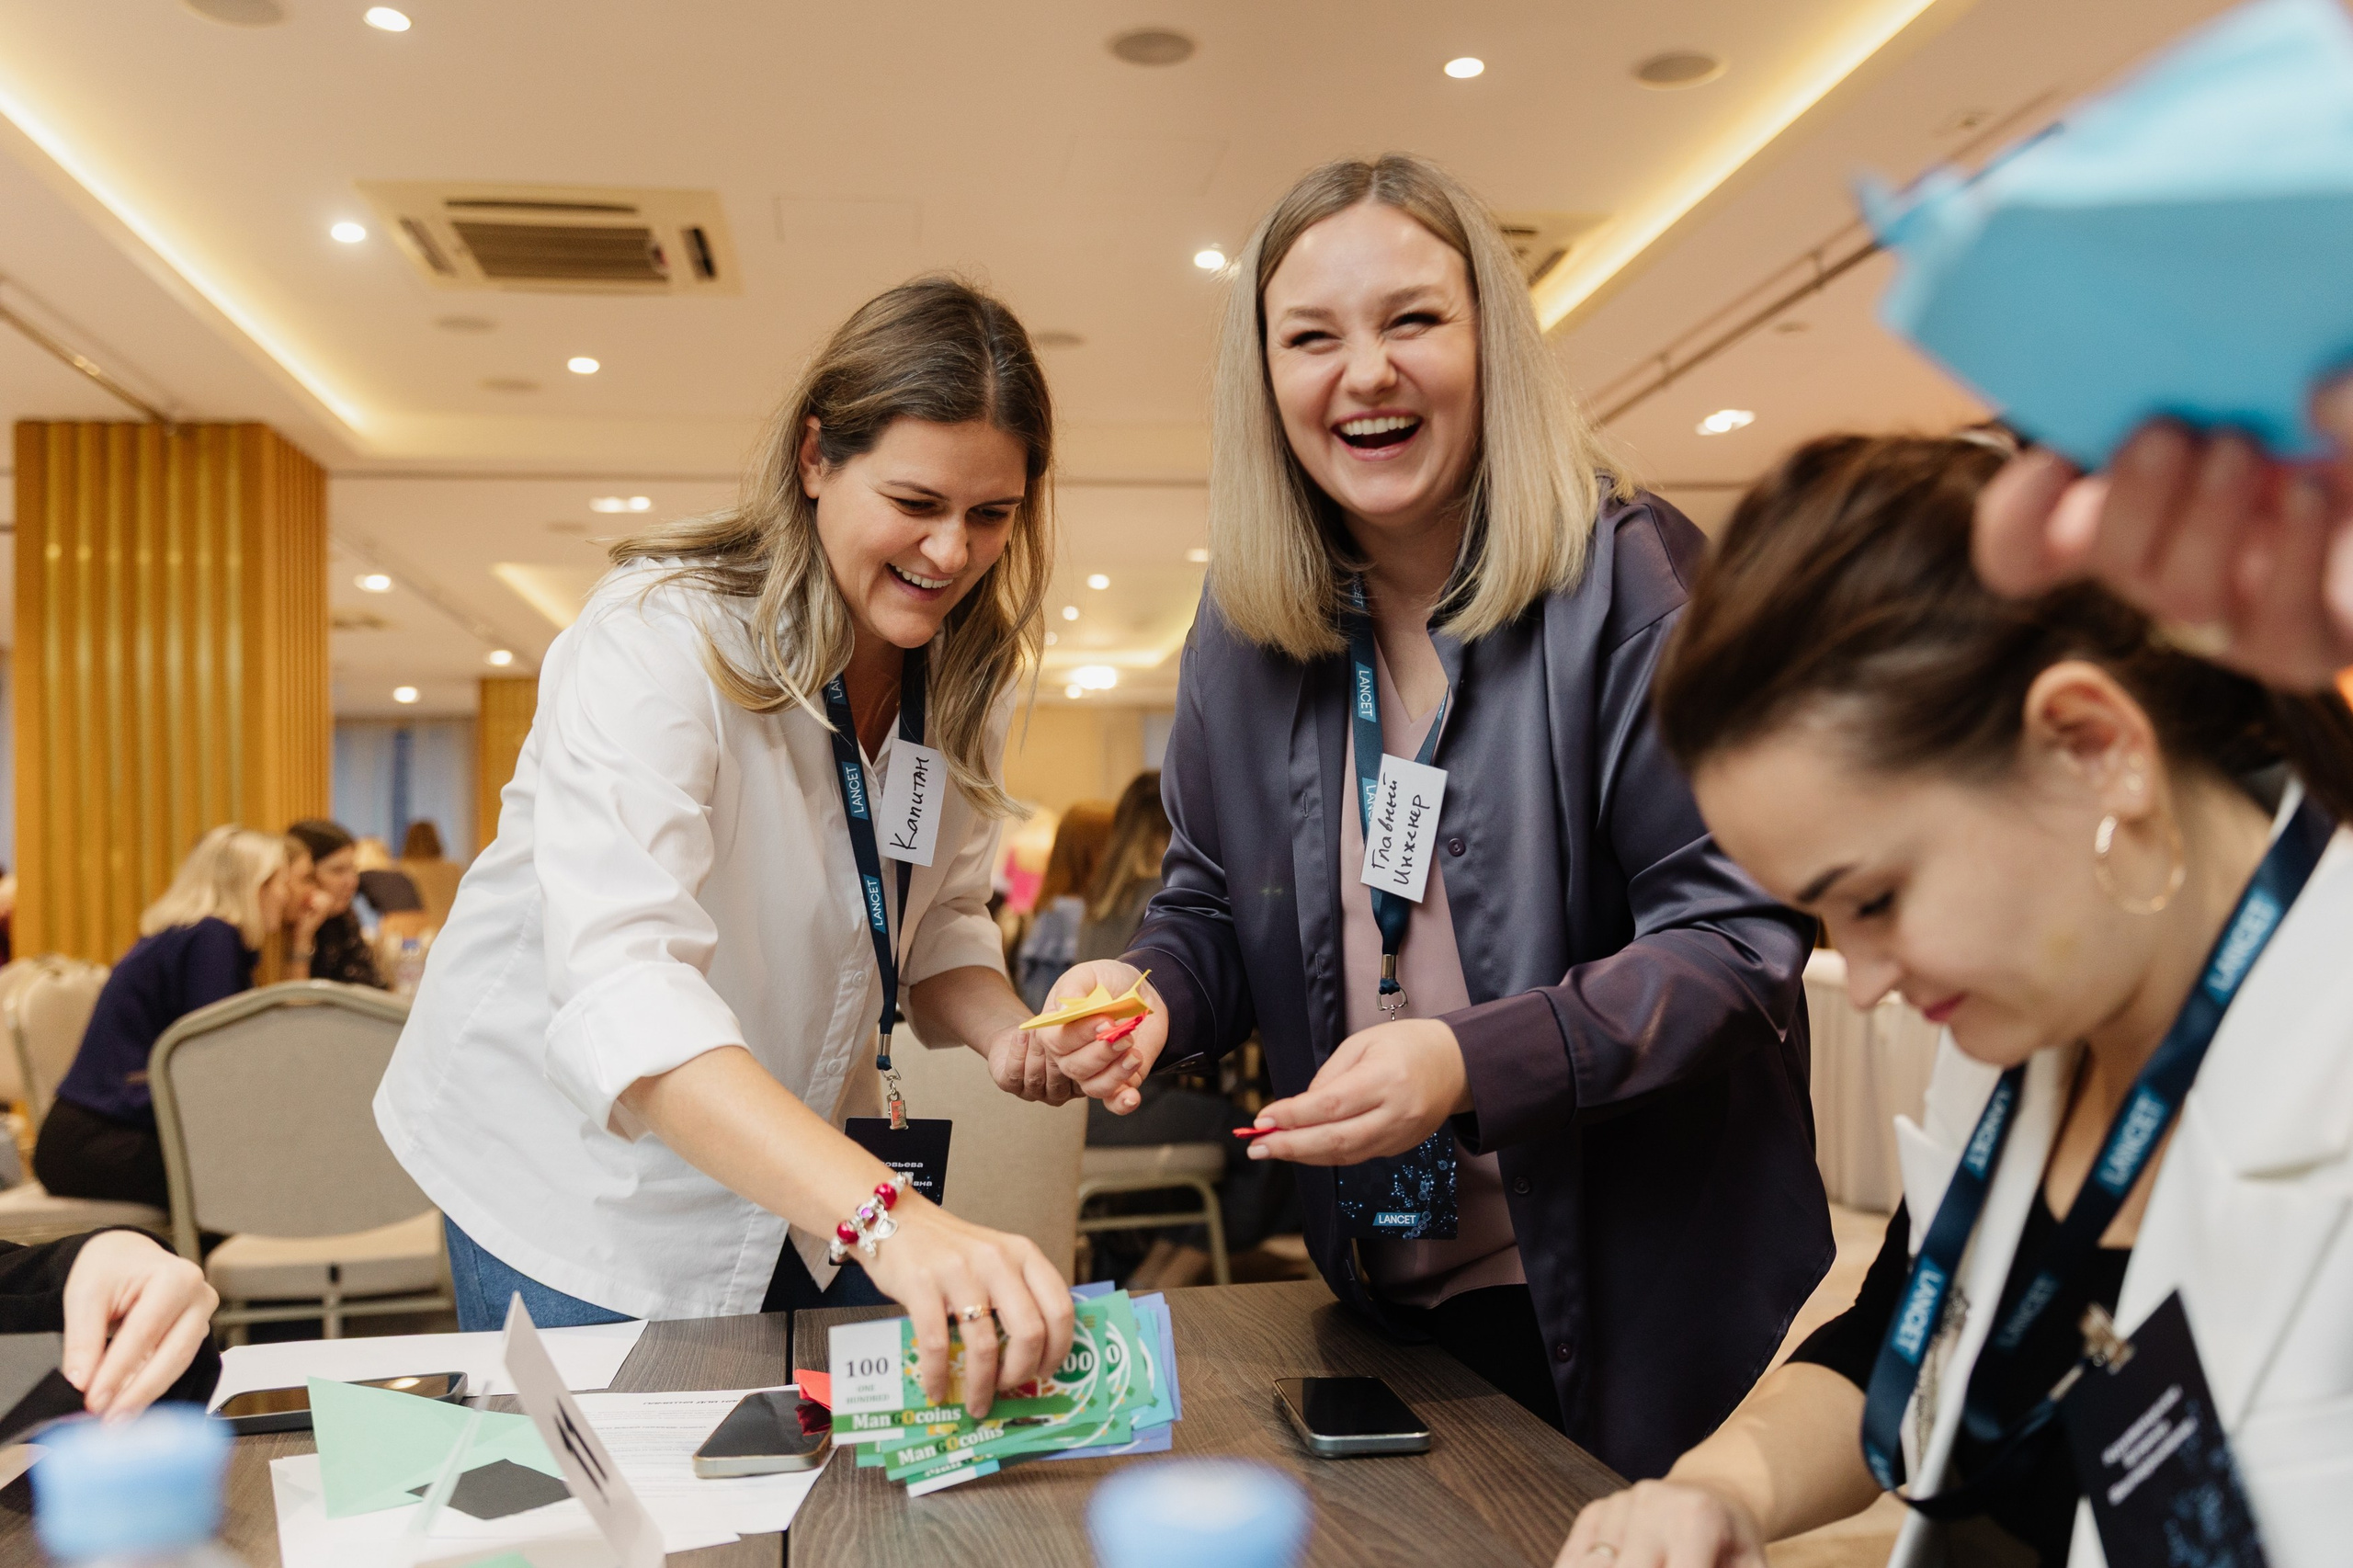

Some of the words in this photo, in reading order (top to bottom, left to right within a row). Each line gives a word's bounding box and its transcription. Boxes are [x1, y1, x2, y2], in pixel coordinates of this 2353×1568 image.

[1358, 669, 1374, 718] LANCET
[846, 766, 865, 814] LANCET
[1370, 771, 1398, 869] Главный
[1392, 793, 1431, 886] Инженер
[867, 879, 884, 926] LANCET
[1379, 1214, 1416, 1225] LANCET
[1895, 1269, 1943, 1356] LANCET
[846, 1357, 890, 1379] 100
[1063, 1351, 1094, 1373] 00
[847, 1393, 891, 1404] HUNDRED
[858, 1383, 876, 1393] ONE
